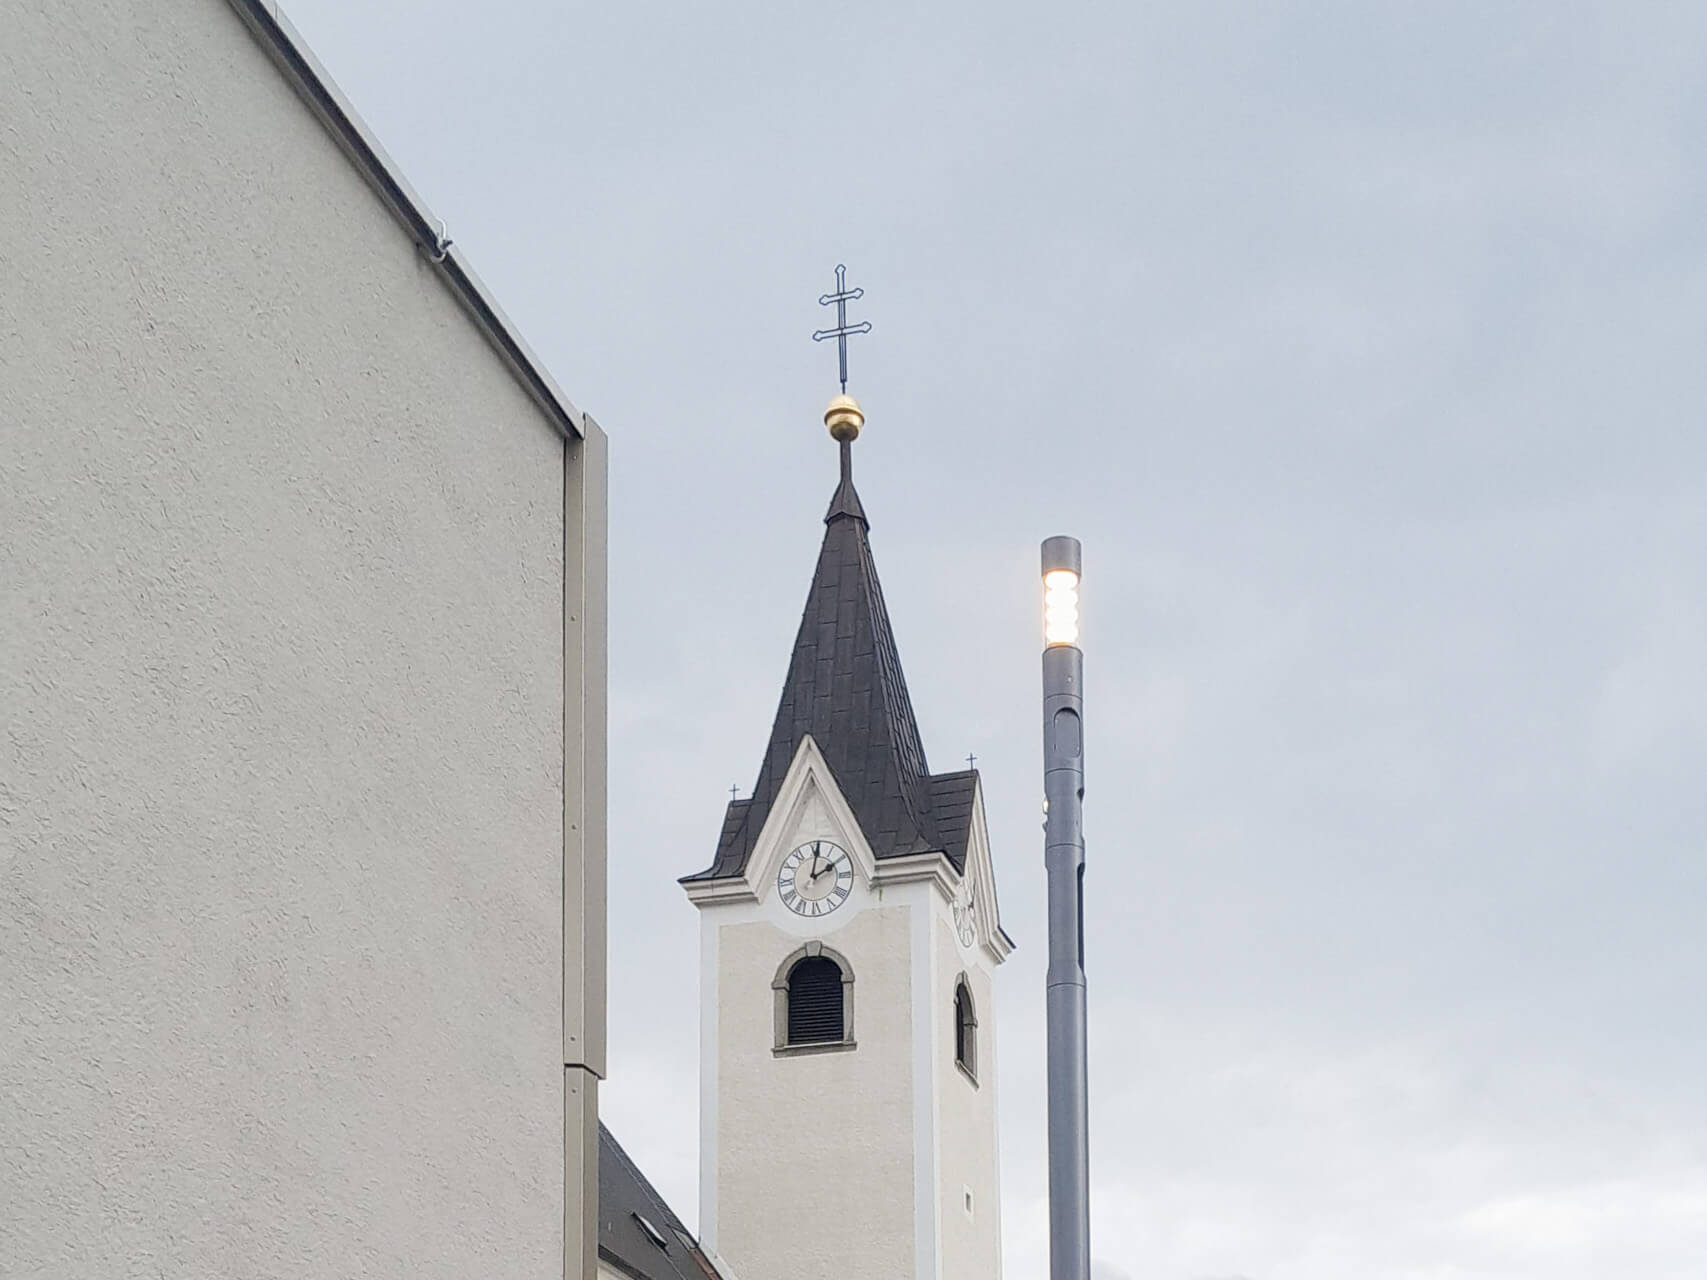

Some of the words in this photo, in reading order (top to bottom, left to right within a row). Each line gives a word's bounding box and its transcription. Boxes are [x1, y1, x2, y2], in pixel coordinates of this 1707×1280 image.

[784, 863, 797, 872] X
[839, 871, 851, 879] III
[826, 898, 836, 912] V
